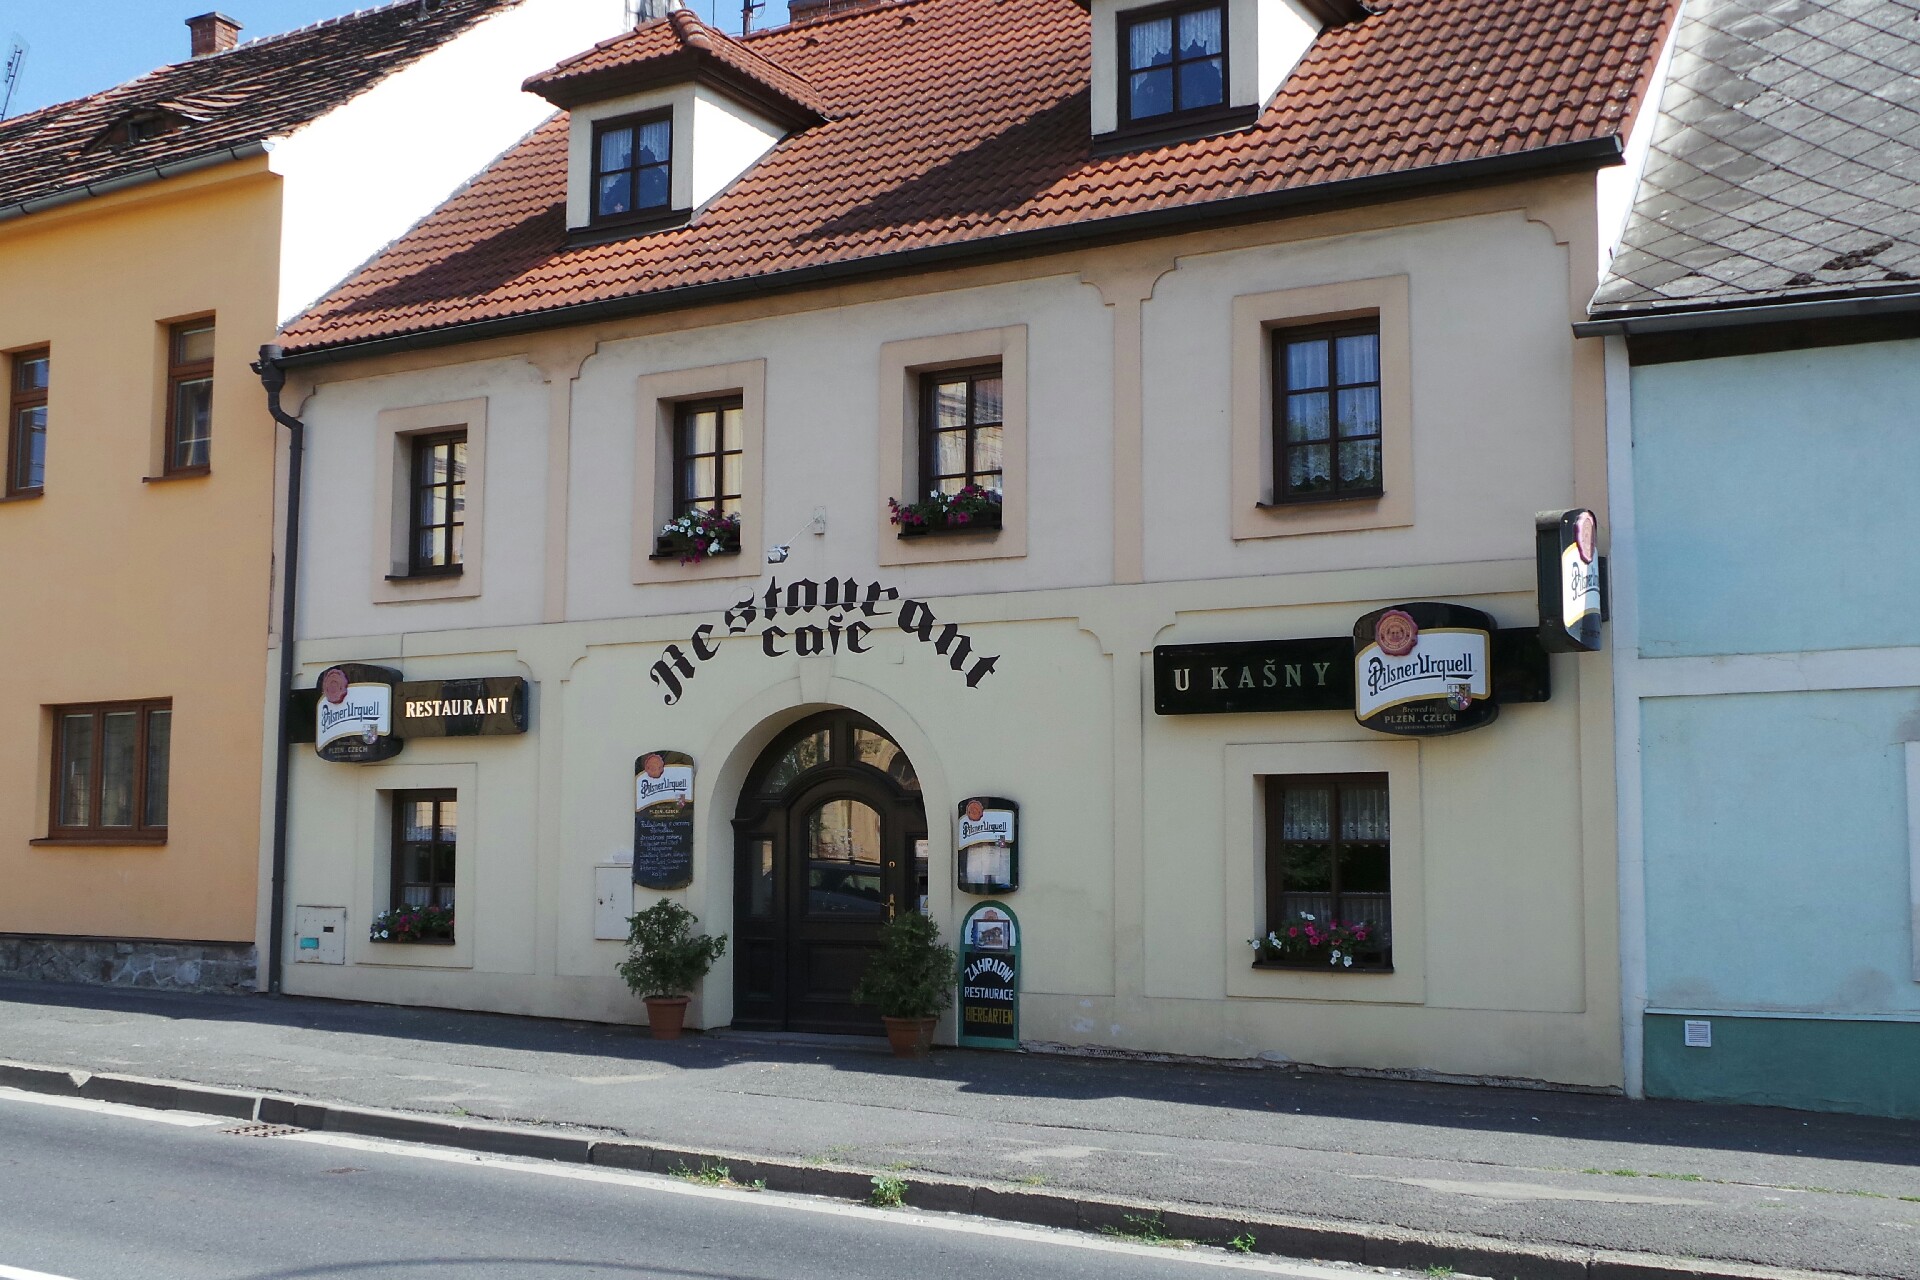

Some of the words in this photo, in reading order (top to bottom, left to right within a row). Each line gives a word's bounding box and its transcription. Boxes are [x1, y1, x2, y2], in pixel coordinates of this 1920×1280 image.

[650, 576, 1000, 706] Restaurant
[1173, 668, 1191, 692] U
[1211, 659, 1331, 690] KAŠNY
[1367, 656, 1418, 697] Pilsner
[1417, 652, 1472, 682] Urquell
[321, 704, 347, 734] Pilsner
[346, 701, 379, 722] Urquell
[405, 697, 509, 718] RESTAURANT
[1422, 713, 1457, 722] CZECH
[640, 779, 664, 799] Pilsner
[663, 778, 687, 792] Urquell
[962, 821, 984, 839] Pilsner
[983, 821, 1007, 833] Urquell
[964, 986, 1014, 1001] RESTAURACE
[965, 1006, 1013, 1025] BIERGARTEN
